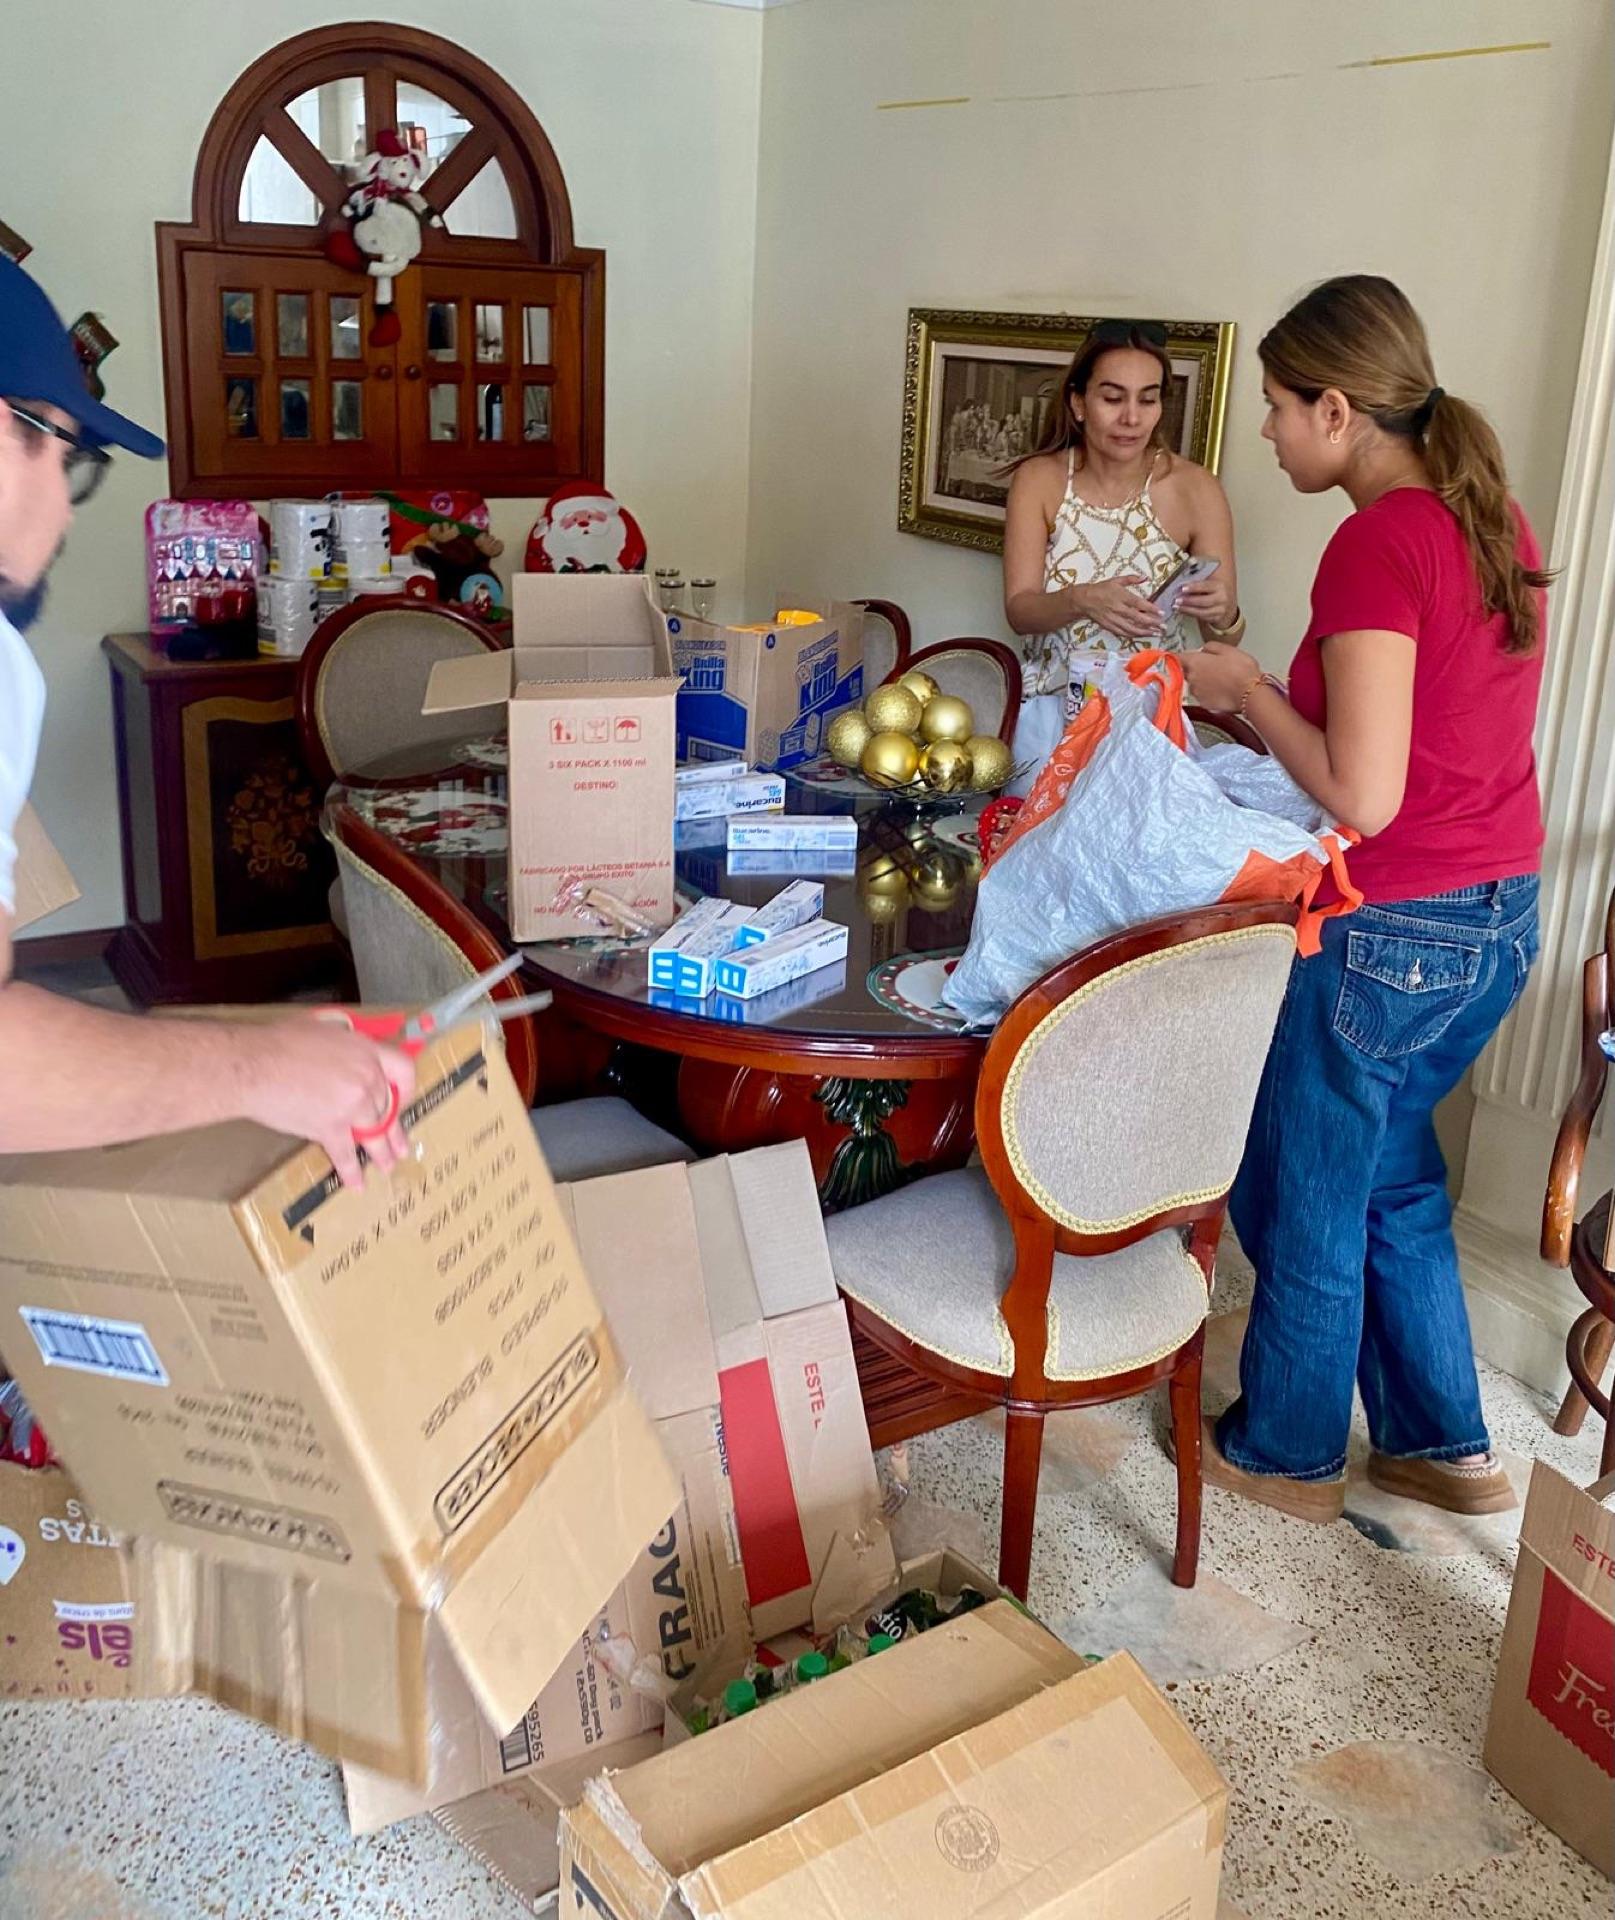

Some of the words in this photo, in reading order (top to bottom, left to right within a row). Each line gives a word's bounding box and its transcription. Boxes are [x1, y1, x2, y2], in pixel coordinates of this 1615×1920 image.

[556, 760, 571, 769] SIX
[575, 760, 602, 768] PACK
[603, 760, 610, 768] X
[574, 781, 616, 791] DESTINO
[568, 865, 584, 873] POR
[421, 1353, 493, 1438] BLENDER
[805, 1362, 825, 1413] ESTE
[1572, 1534, 1615, 1579] ESTE
